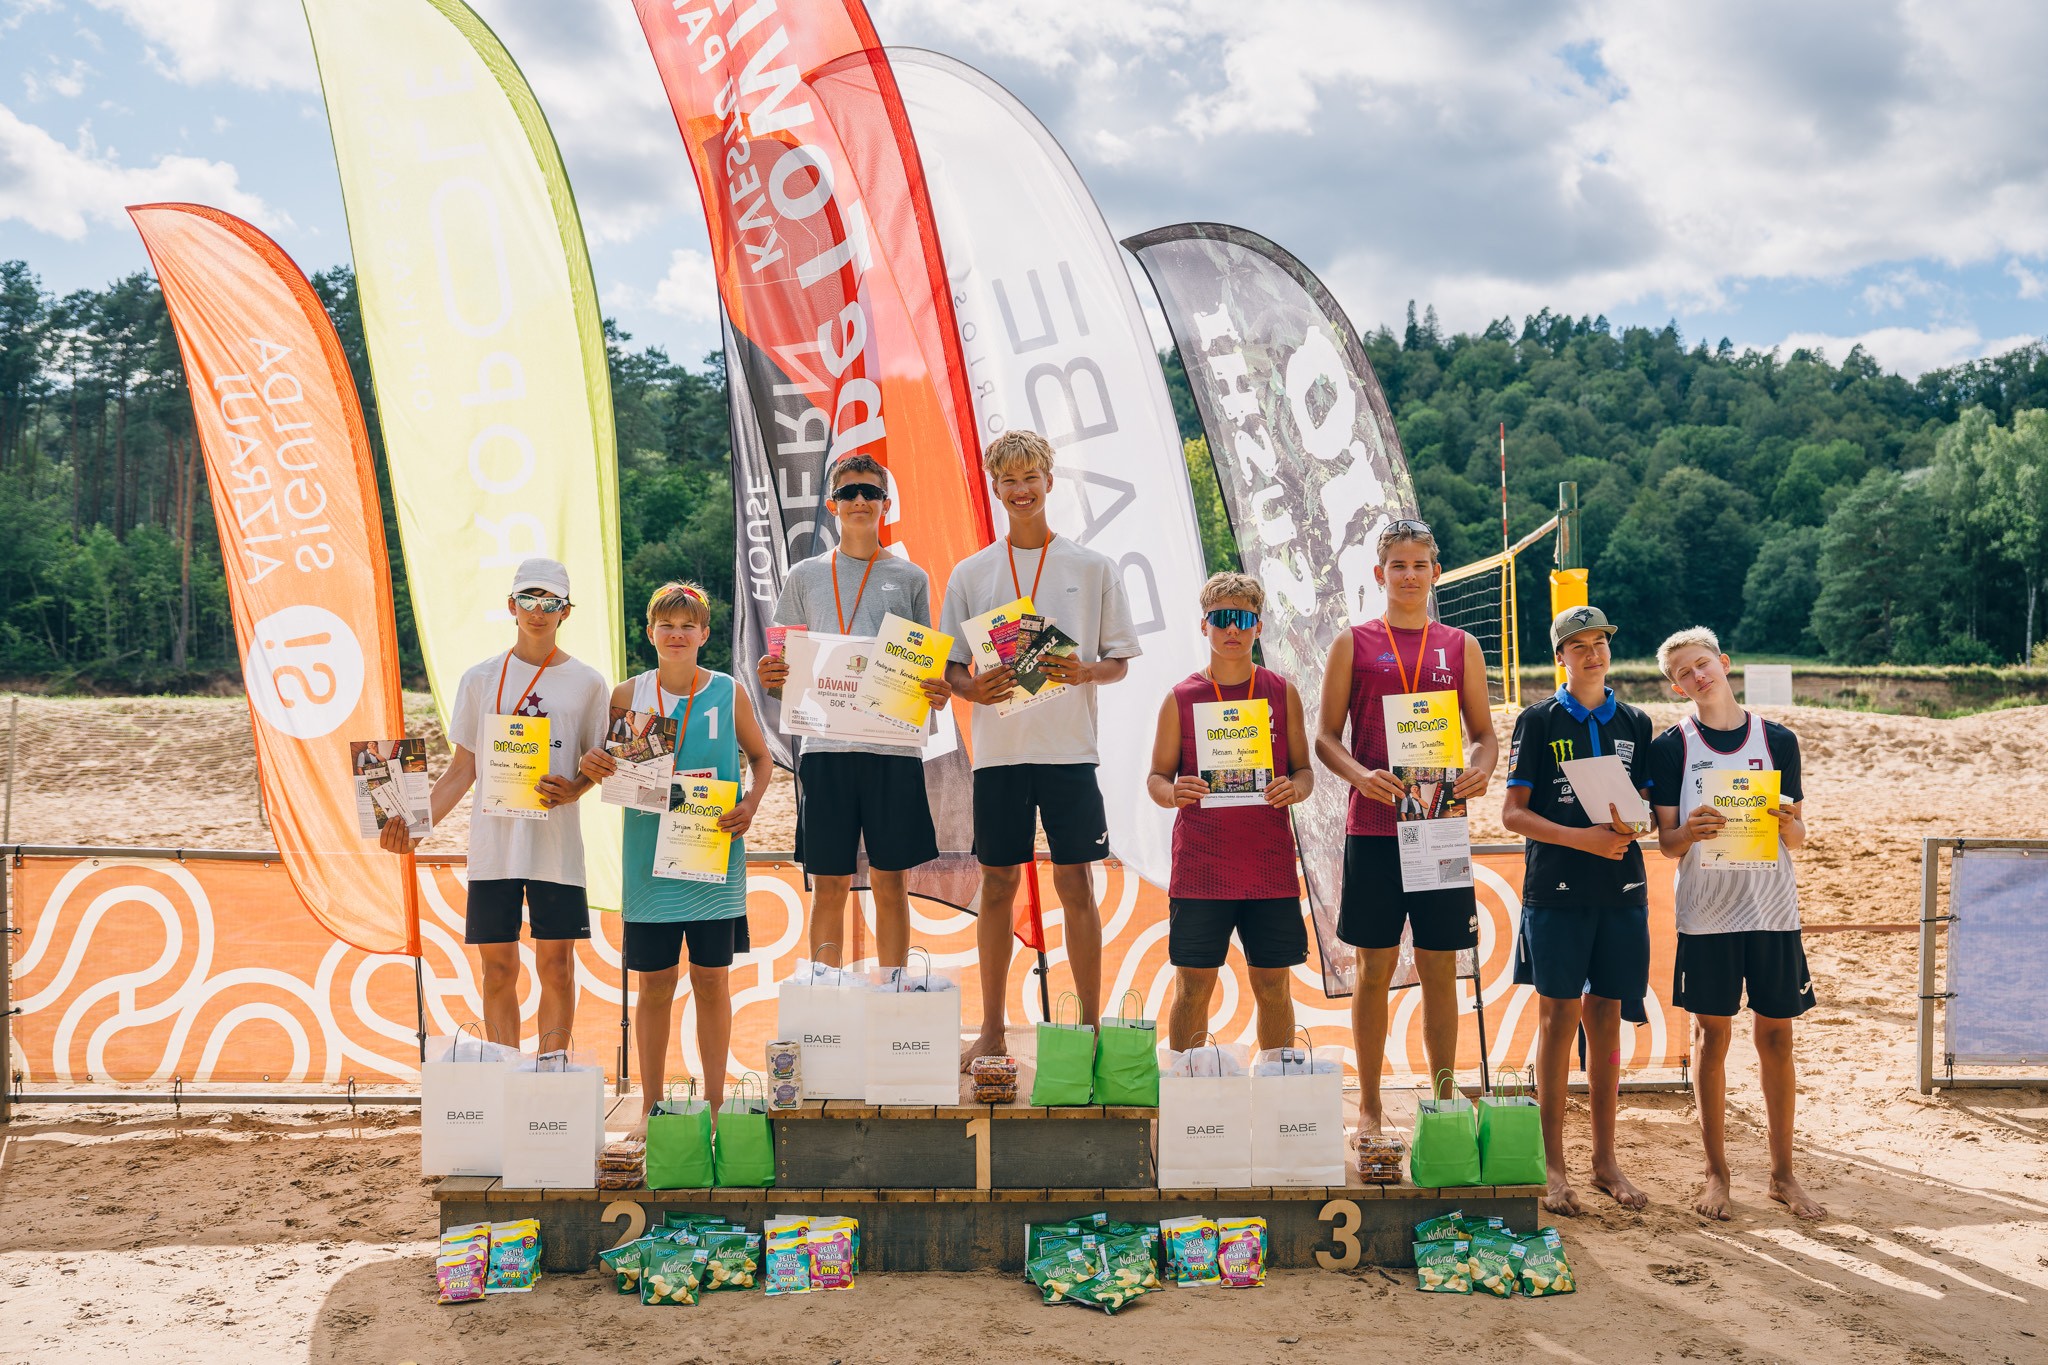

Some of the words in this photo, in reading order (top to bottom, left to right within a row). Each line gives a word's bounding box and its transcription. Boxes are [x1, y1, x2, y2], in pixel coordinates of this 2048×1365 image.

[885, 642, 934, 669] DIPLOMS
[1433, 647, 1451, 672] 1
[1431, 672, 1453, 685] LAT
[830, 700, 846, 708] 50€
[703, 706, 719, 740] 1
[1397, 718, 1448, 734] DIPLOMS
[1207, 726, 1258, 741] DIPLOMS
[494, 740, 539, 754] DIPLOMS
[1714, 795, 1767, 808] DIPLOMS
[674, 802, 723, 818] DIPLOMS
[804, 1034, 841, 1044] BABE
[892, 1041, 930, 1051] BABE
[447, 1111, 484, 1120] BABE
[529, 1122, 568, 1131] BABE
[1186, 1124, 1224, 1135] BABE
[1279, 1122, 1317, 1133] BABE
[966, 1118, 991, 1190] 1
[600, 1200, 646, 1274] 2
[1315, 1200, 1362, 1270] 3
[1427, 1223, 1458, 1241] Naturals
[716, 1247, 749, 1260] Naturals
[1120, 1252, 1150, 1266] Naturals
[1426, 1254, 1458, 1266] Naturals
[1477, 1247, 1508, 1264] Naturals
[1524, 1250, 1556, 1267] Naturals
[502, 1270, 521, 1278] max
[660, 1260, 694, 1275] Naturals
[820, 1265, 840, 1274] mix
[1046, 1264, 1078, 1279] Naturals
[1229, 1264, 1248, 1273] mix
[450, 1280, 470, 1289] mix
